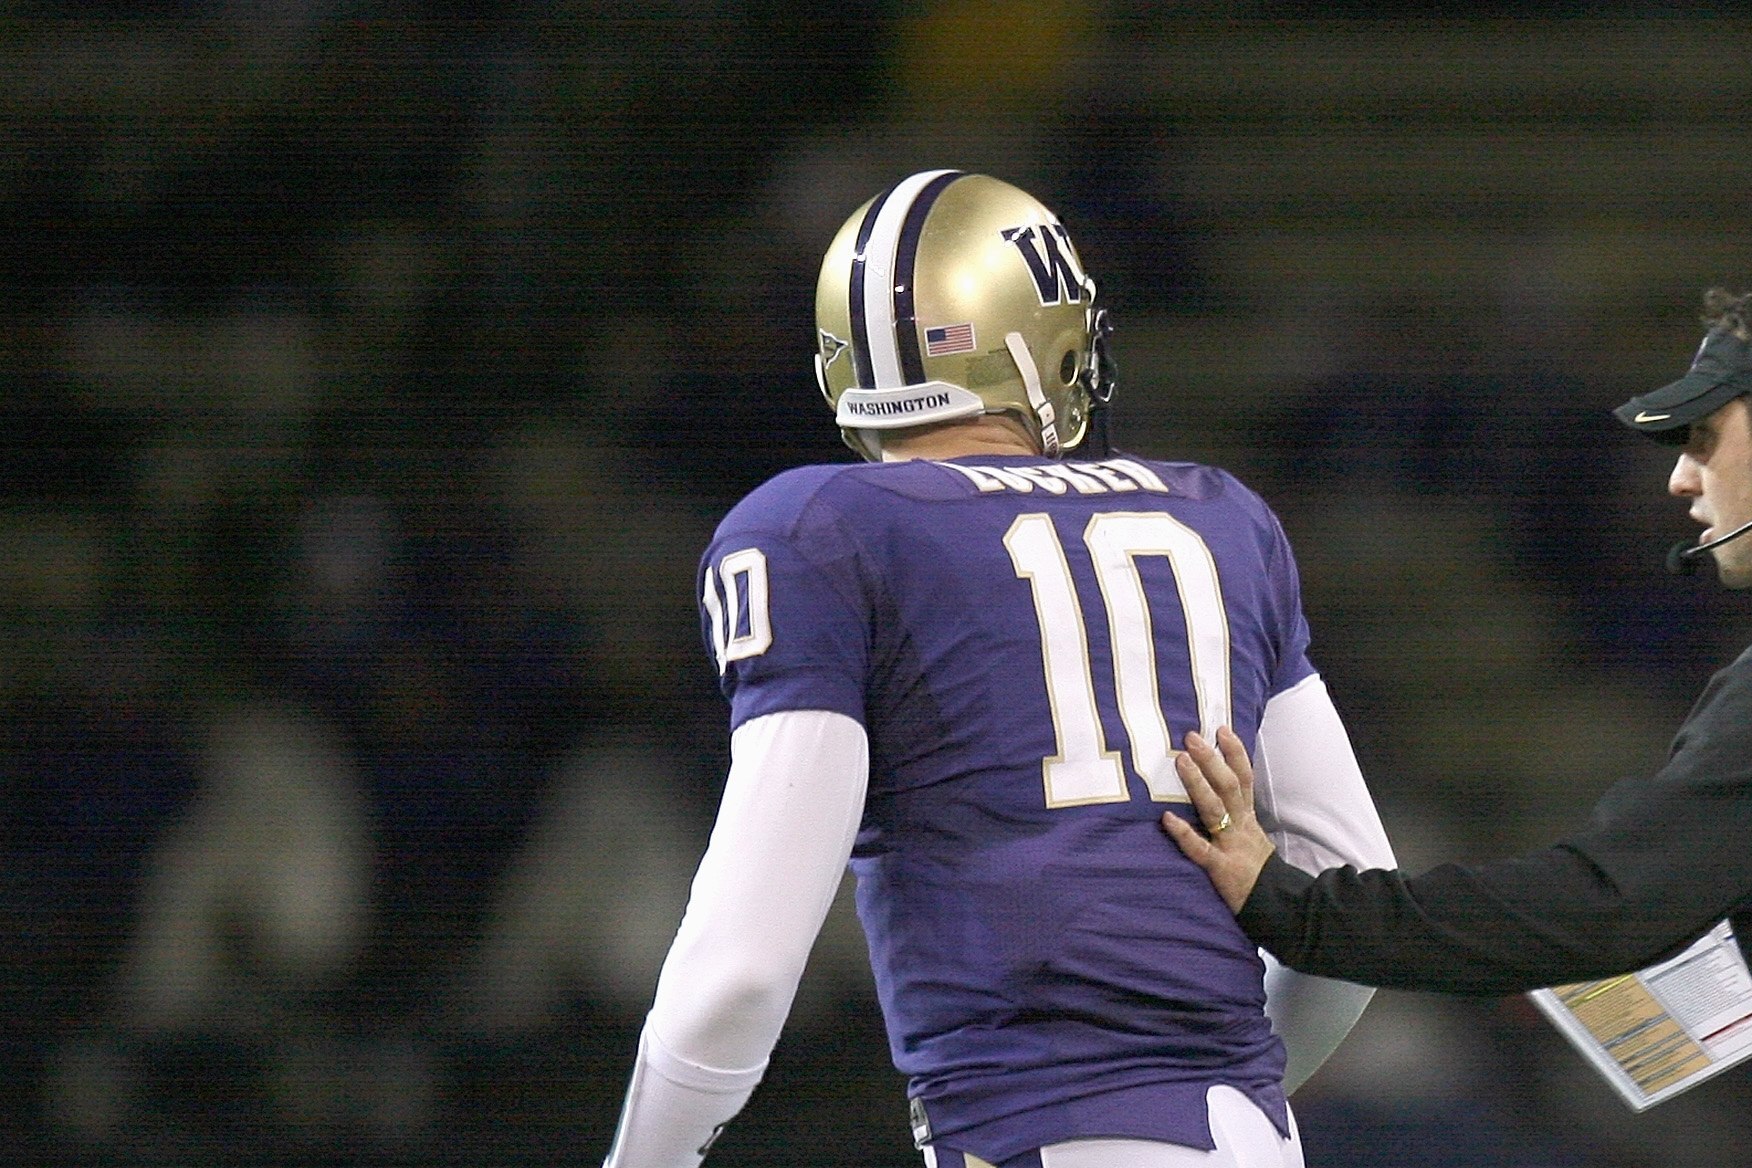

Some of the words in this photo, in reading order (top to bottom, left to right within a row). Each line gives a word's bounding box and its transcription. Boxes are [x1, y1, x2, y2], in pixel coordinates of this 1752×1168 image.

[1000, 223, 1081, 307] W
[846, 391, 950, 416] WASHINGTON
[702, 547, 774, 677] 10
[1002, 511, 1233, 809] 10
